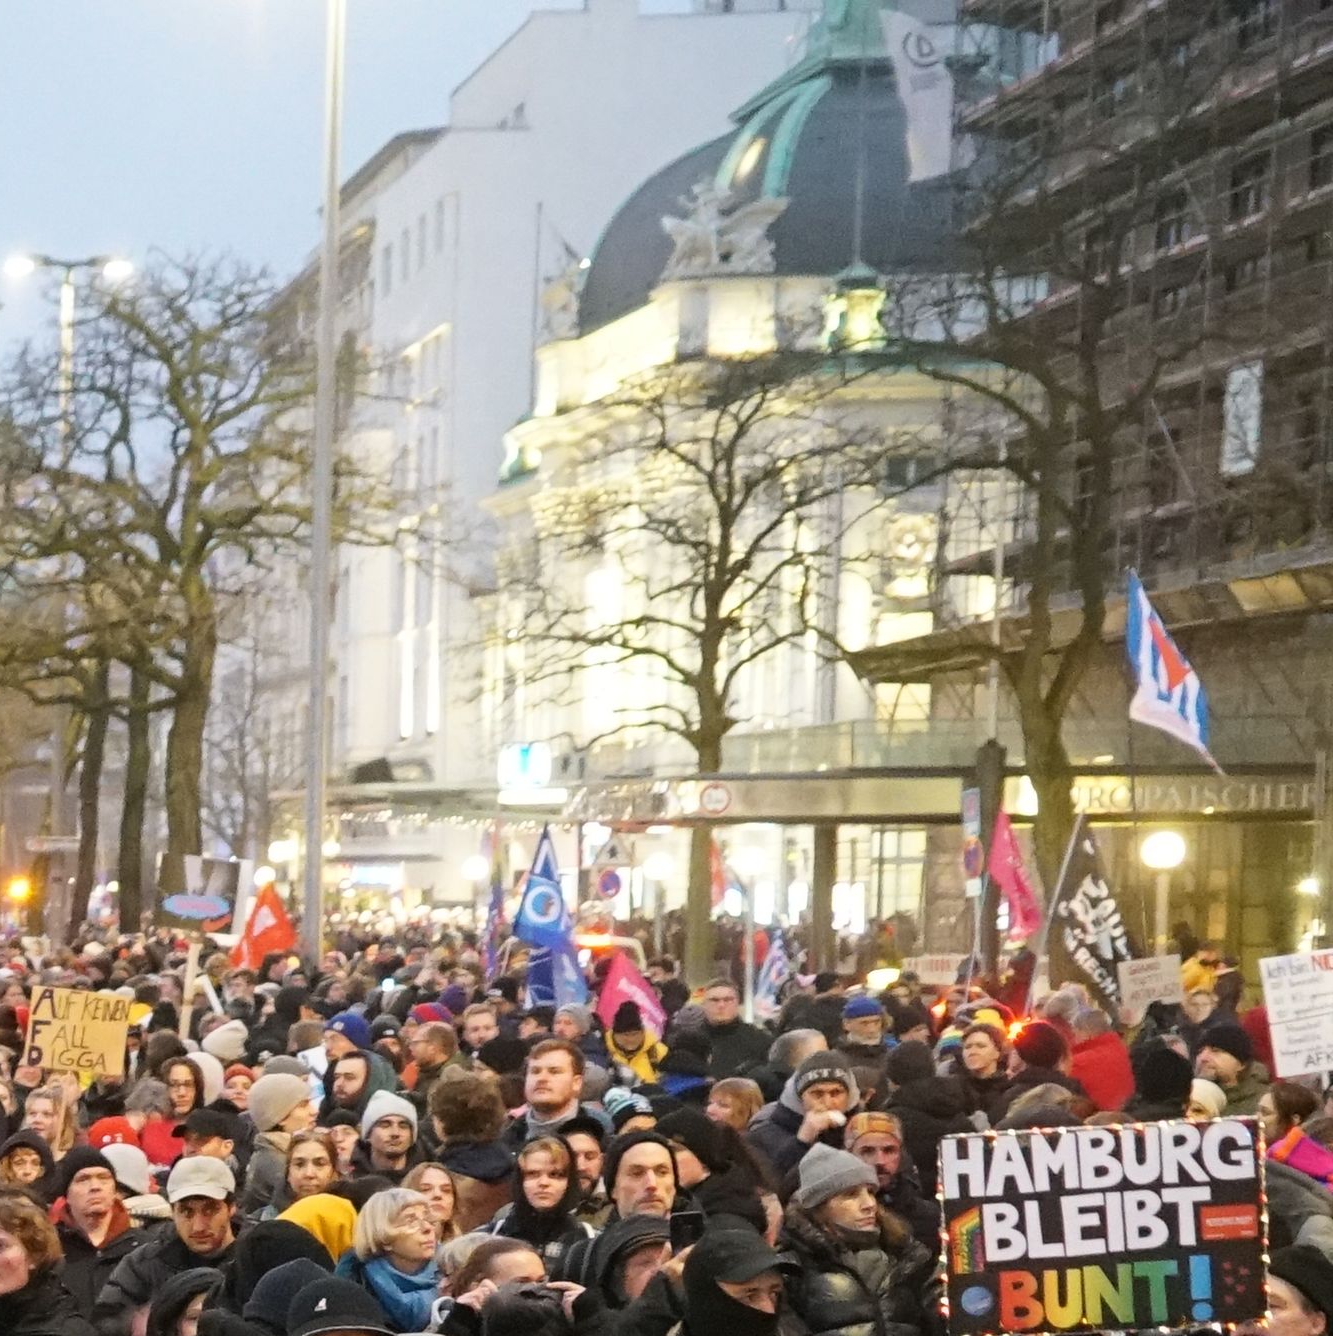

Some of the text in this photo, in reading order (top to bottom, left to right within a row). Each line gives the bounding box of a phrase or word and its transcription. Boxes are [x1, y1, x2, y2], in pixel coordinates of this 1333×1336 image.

[941, 1120, 1256, 1200] HAMBURG
[982, 1186, 1212, 1263] BLEIBT
[999, 1254, 1214, 1332] BUNT!
